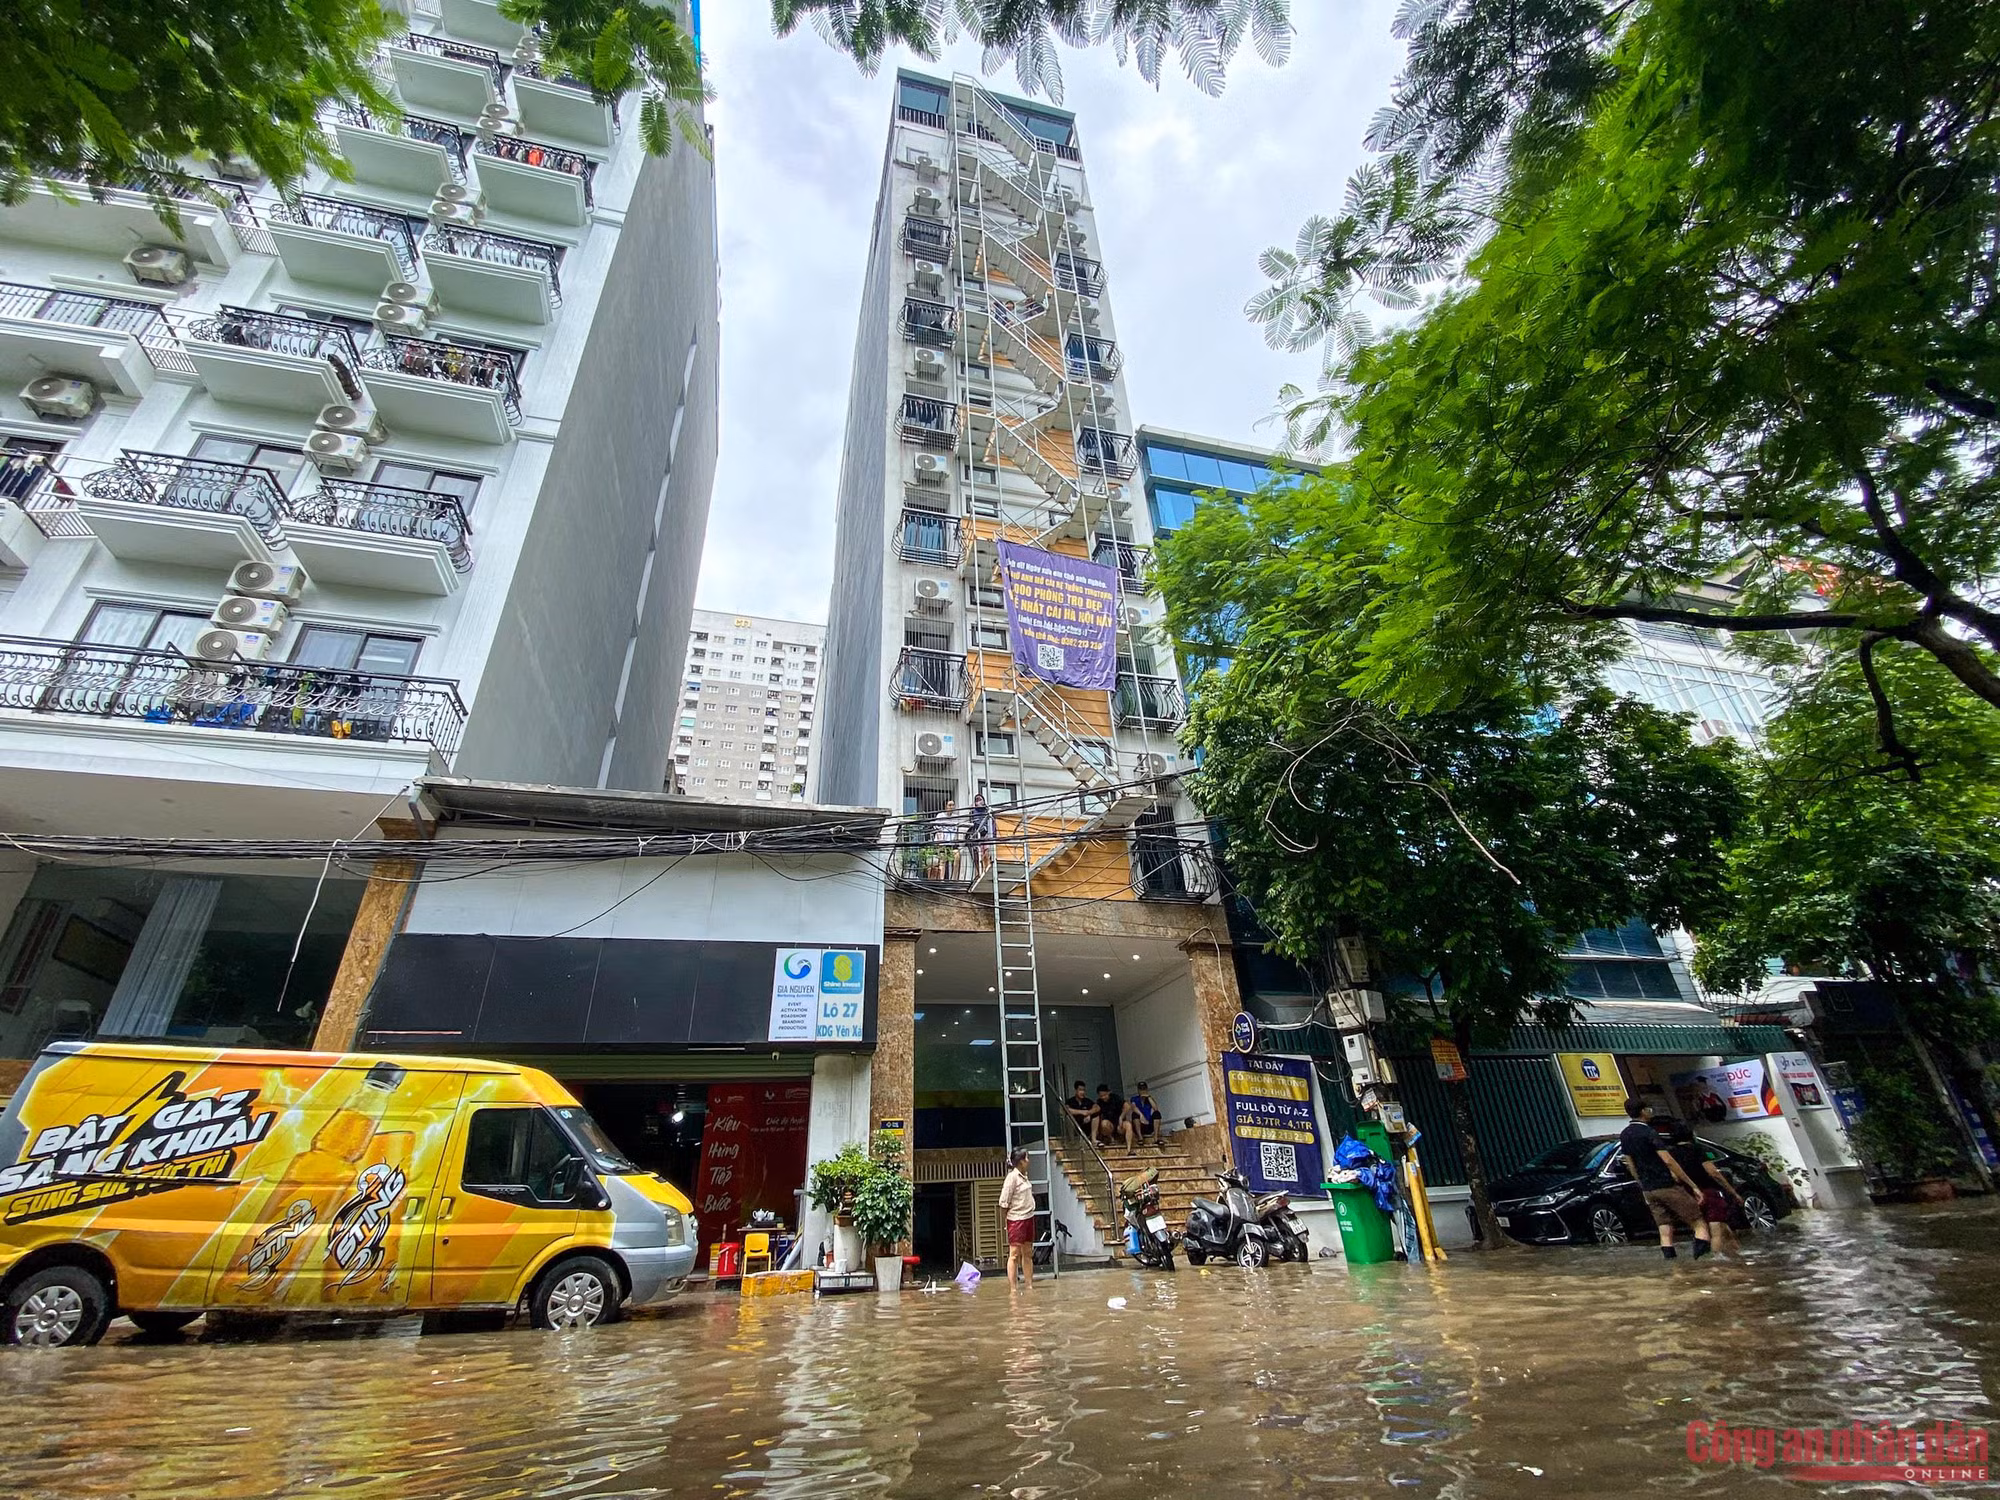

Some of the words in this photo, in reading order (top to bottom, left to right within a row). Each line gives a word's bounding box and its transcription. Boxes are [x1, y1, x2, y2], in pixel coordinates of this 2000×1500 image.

[1034, 586, 1064, 604] PHÒNG
[1067, 593, 1084, 608] TRỌ
[1046, 604, 1062, 620] CÁI
[1064, 608, 1076, 622] HÀ
[777, 985, 788, 994] GIA
[823, 1002, 838, 1018] Lô
[842, 1003, 858, 1018] 27
[835, 1025, 850, 1038] Yên
[1264, 1060, 1284, 1071] ĐÂY
[1728, 1068, 1752, 1081] ĐỨC
[1250, 1086, 1268, 1095] CHO
[1236, 1102, 1260, 1112] FULL
[1261, 1102, 1276, 1114] ĐỒ
[1278, 1104, 1292, 1115] TỪ
[1294, 1108, 1309, 1117] A-Z
[30, 1116, 127, 1157] BẬT
[153, 1090, 251, 1130] GAZ
[1236, 1114, 1254, 1124] GIÁ
[127, 1113, 269, 1168] KHOÁI
[7, 1182, 79, 1220] SUNG
[188, 1151, 230, 1178] THÌ
[336, 1171, 405, 1268] STING
